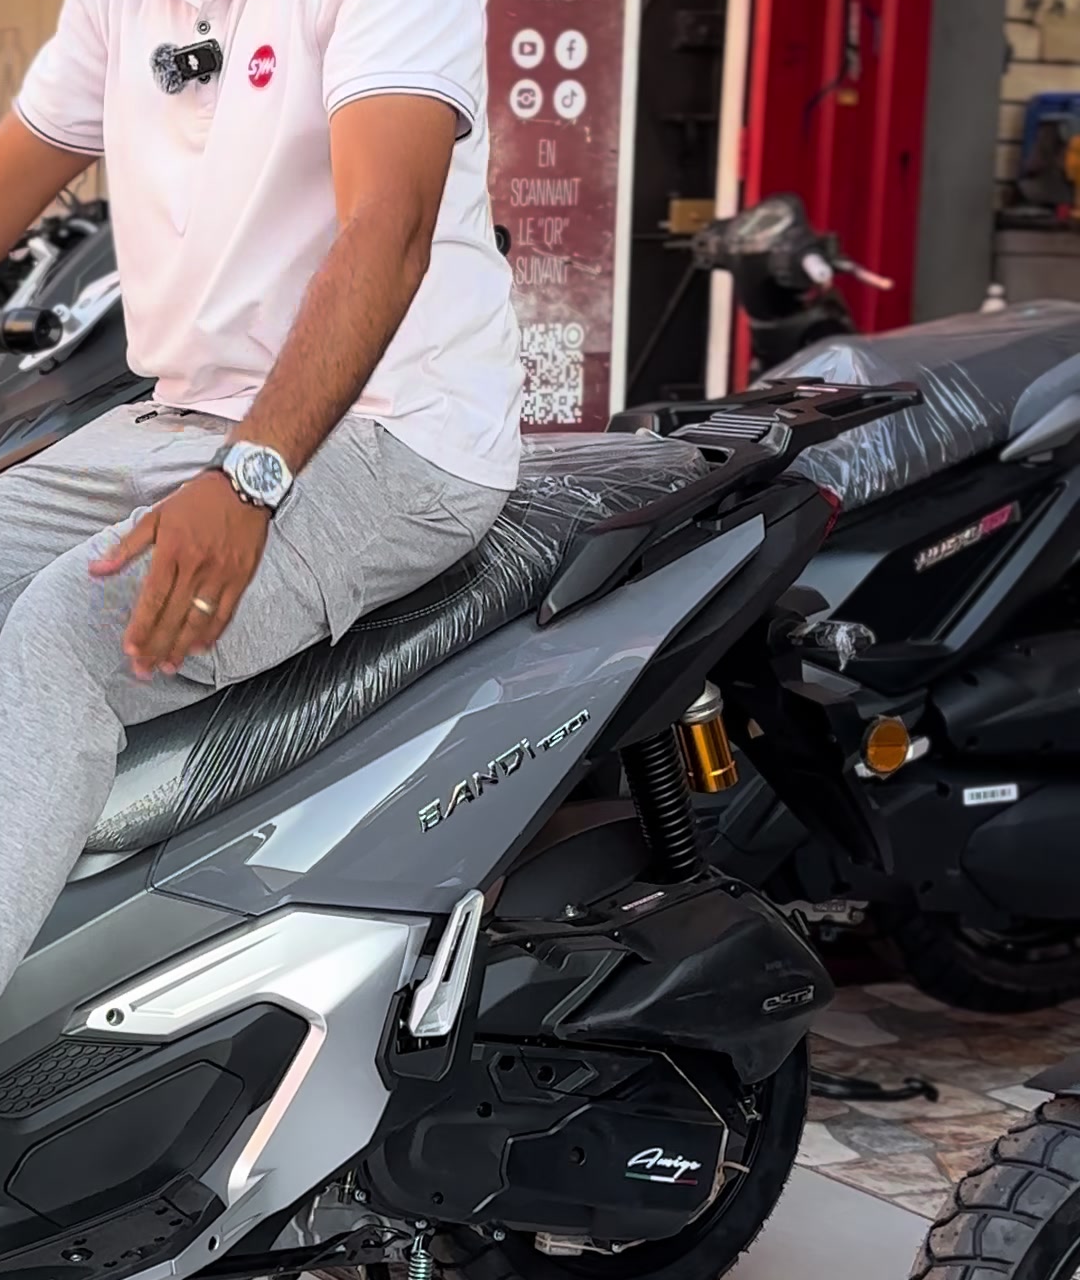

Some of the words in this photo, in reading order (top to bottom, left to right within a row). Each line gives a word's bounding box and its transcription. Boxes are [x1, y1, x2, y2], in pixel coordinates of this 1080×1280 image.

[247, 57, 277, 79] SYM
[537, 138, 557, 168] EN
[510, 177, 582, 207] SCANNANT
[519, 217, 534, 246] LE
[537, 218, 571, 250] "QR"
[515, 256, 571, 286] SUIVANT
[627, 1147, 702, 1179] Amigo
